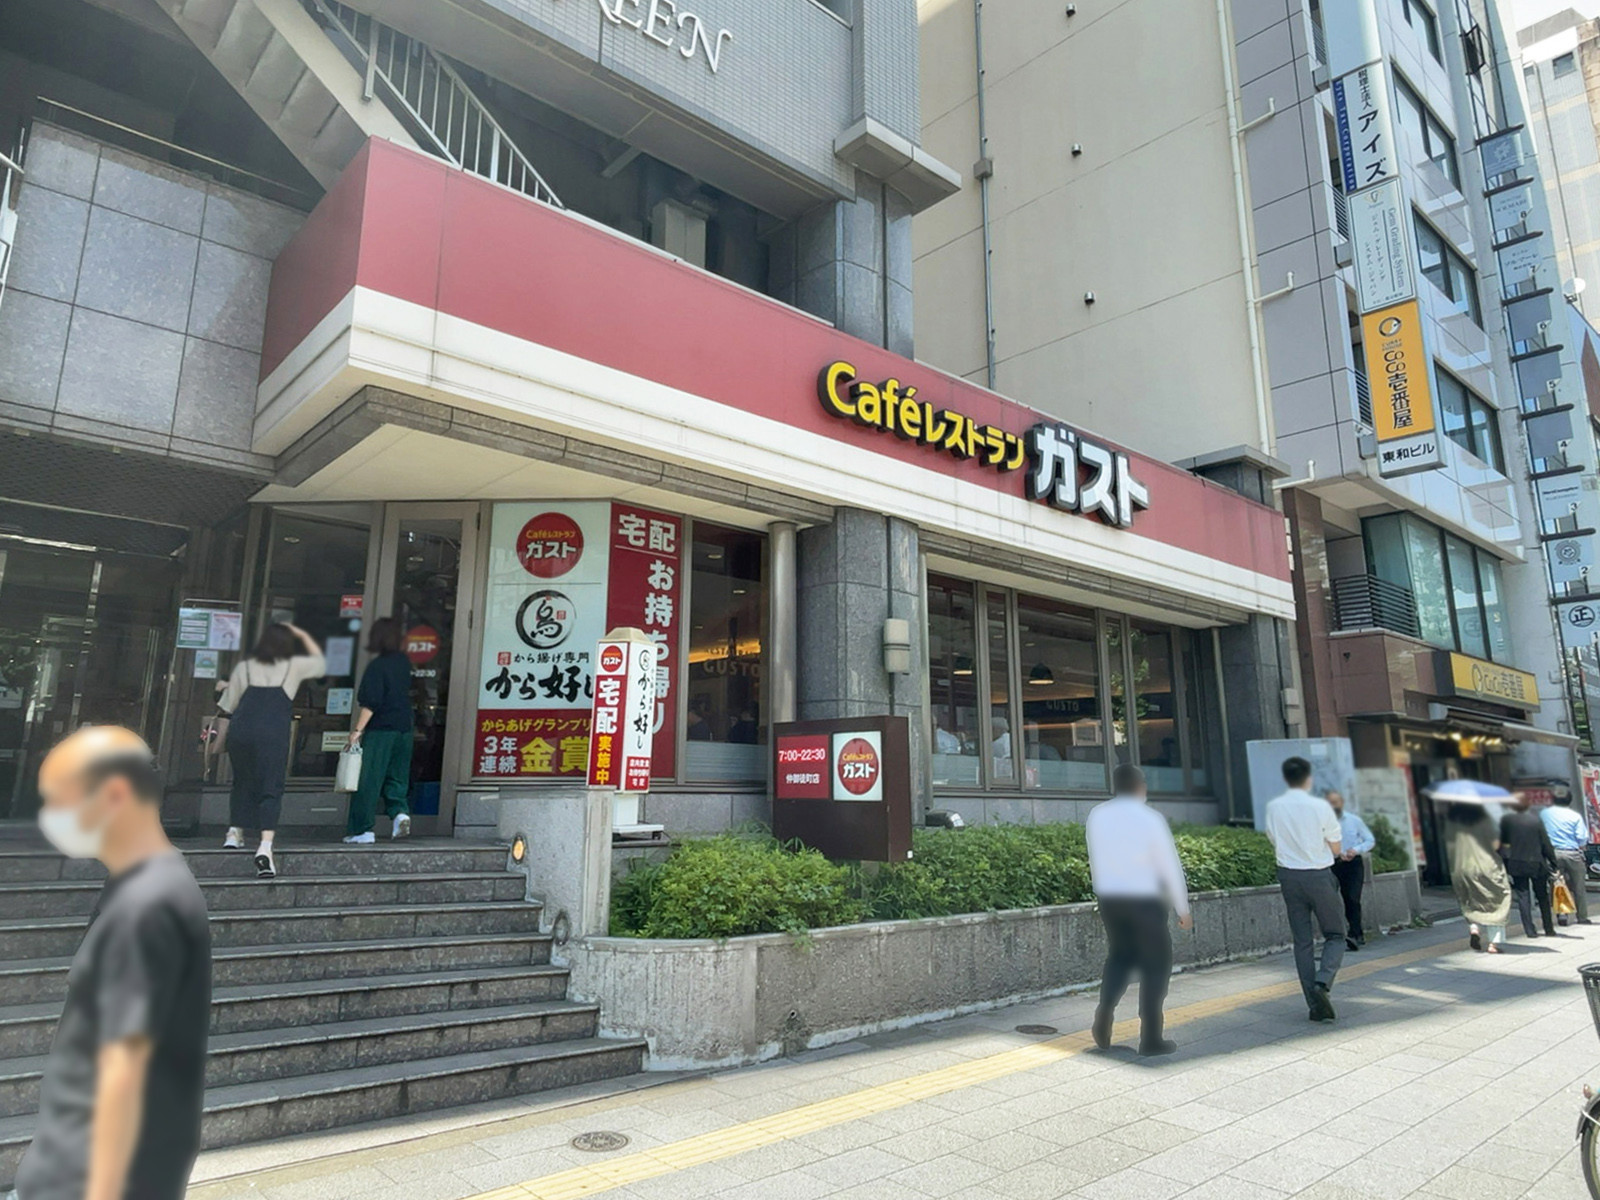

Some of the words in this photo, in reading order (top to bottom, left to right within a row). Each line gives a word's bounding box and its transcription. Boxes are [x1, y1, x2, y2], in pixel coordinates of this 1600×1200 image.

[1358, 109, 1387, 182] アイズ
[1530, 265, 1536, 274] 7
[1549, 380, 1556, 389] 5
[1560, 440, 1568, 448] 4
[1382, 443, 1435, 464] 東和ビル
[1031, 423, 1149, 528] ガスト
[1570, 502, 1578, 511] 3
[618, 513, 676, 552] 宅配
[525, 541, 577, 559] ガスト
[1581, 566, 1590, 576] 2
[514, 652, 590, 664] から揚げ専門
[602, 657, 622, 666] ガスト
[485, 664, 595, 703] から好し
[596, 678, 621, 734] 宅配
[633, 673, 651, 750] から好し
[481, 718, 592, 733] からあげグランプリ
[484, 735, 518, 754] 3年
[520, 736, 589, 774] 金賞
[596, 735, 612, 785] 実施中
[778, 748, 826, 762] 7:00-22:30
[479, 755, 518, 774] 連続
[842, 762, 876, 779] ガスト
